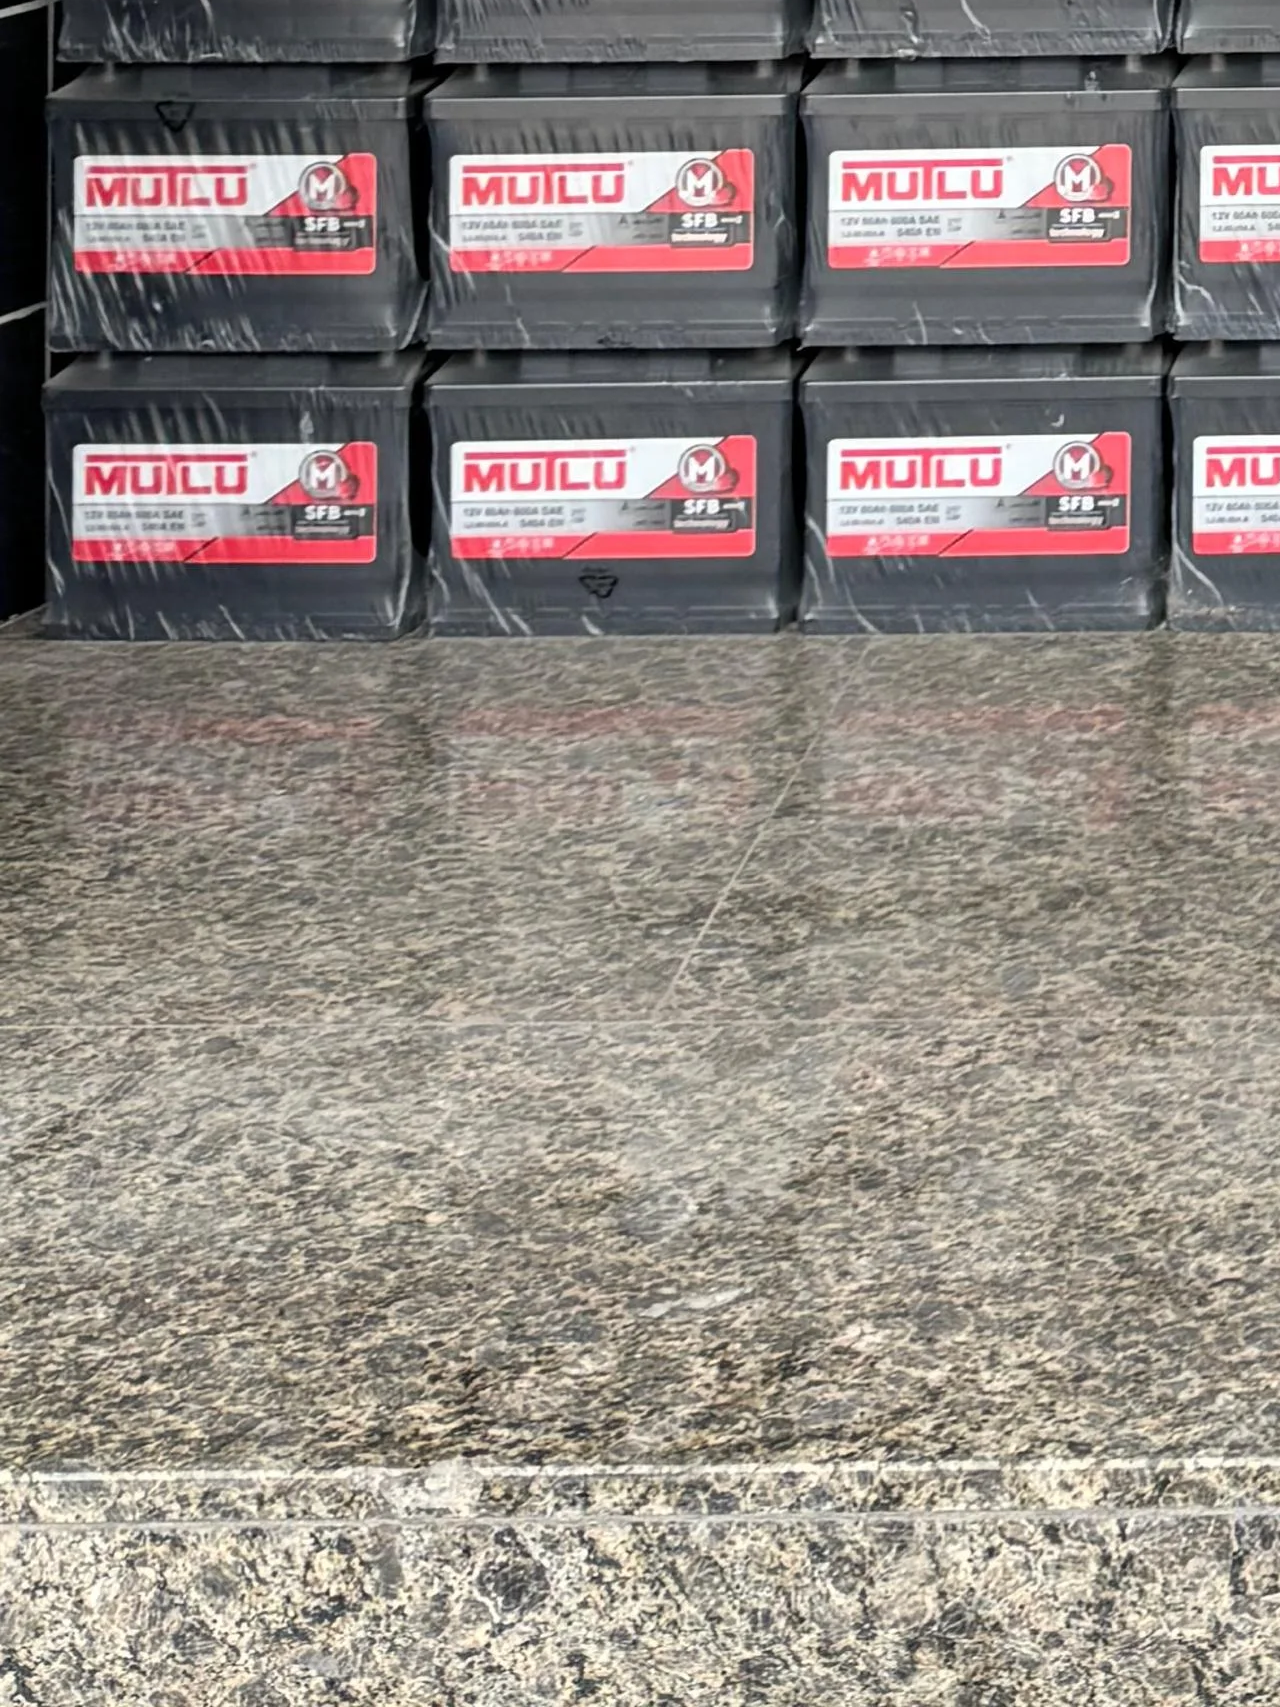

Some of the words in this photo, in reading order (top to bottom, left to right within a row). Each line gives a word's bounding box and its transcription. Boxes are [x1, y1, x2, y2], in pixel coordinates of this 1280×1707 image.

[86, 166, 247, 207] MUTLU
[462, 163, 624, 206] MUTLU
[842, 159, 1003, 201] MUTLU
[304, 217, 341, 231] SFB
[681, 213, 718, 228] SFB
[1059, 208, 1096, 223] SFB
[85, 454, 247, 495] MUTLU
[464, 450, 626, 492] MUTLU
[840, 447, 1001, 490] MUTLU
[304, 505, 341, 520] SFB
[683, 499, 720, 514] SFB
[1058, 496, 1095, 511] SFB
